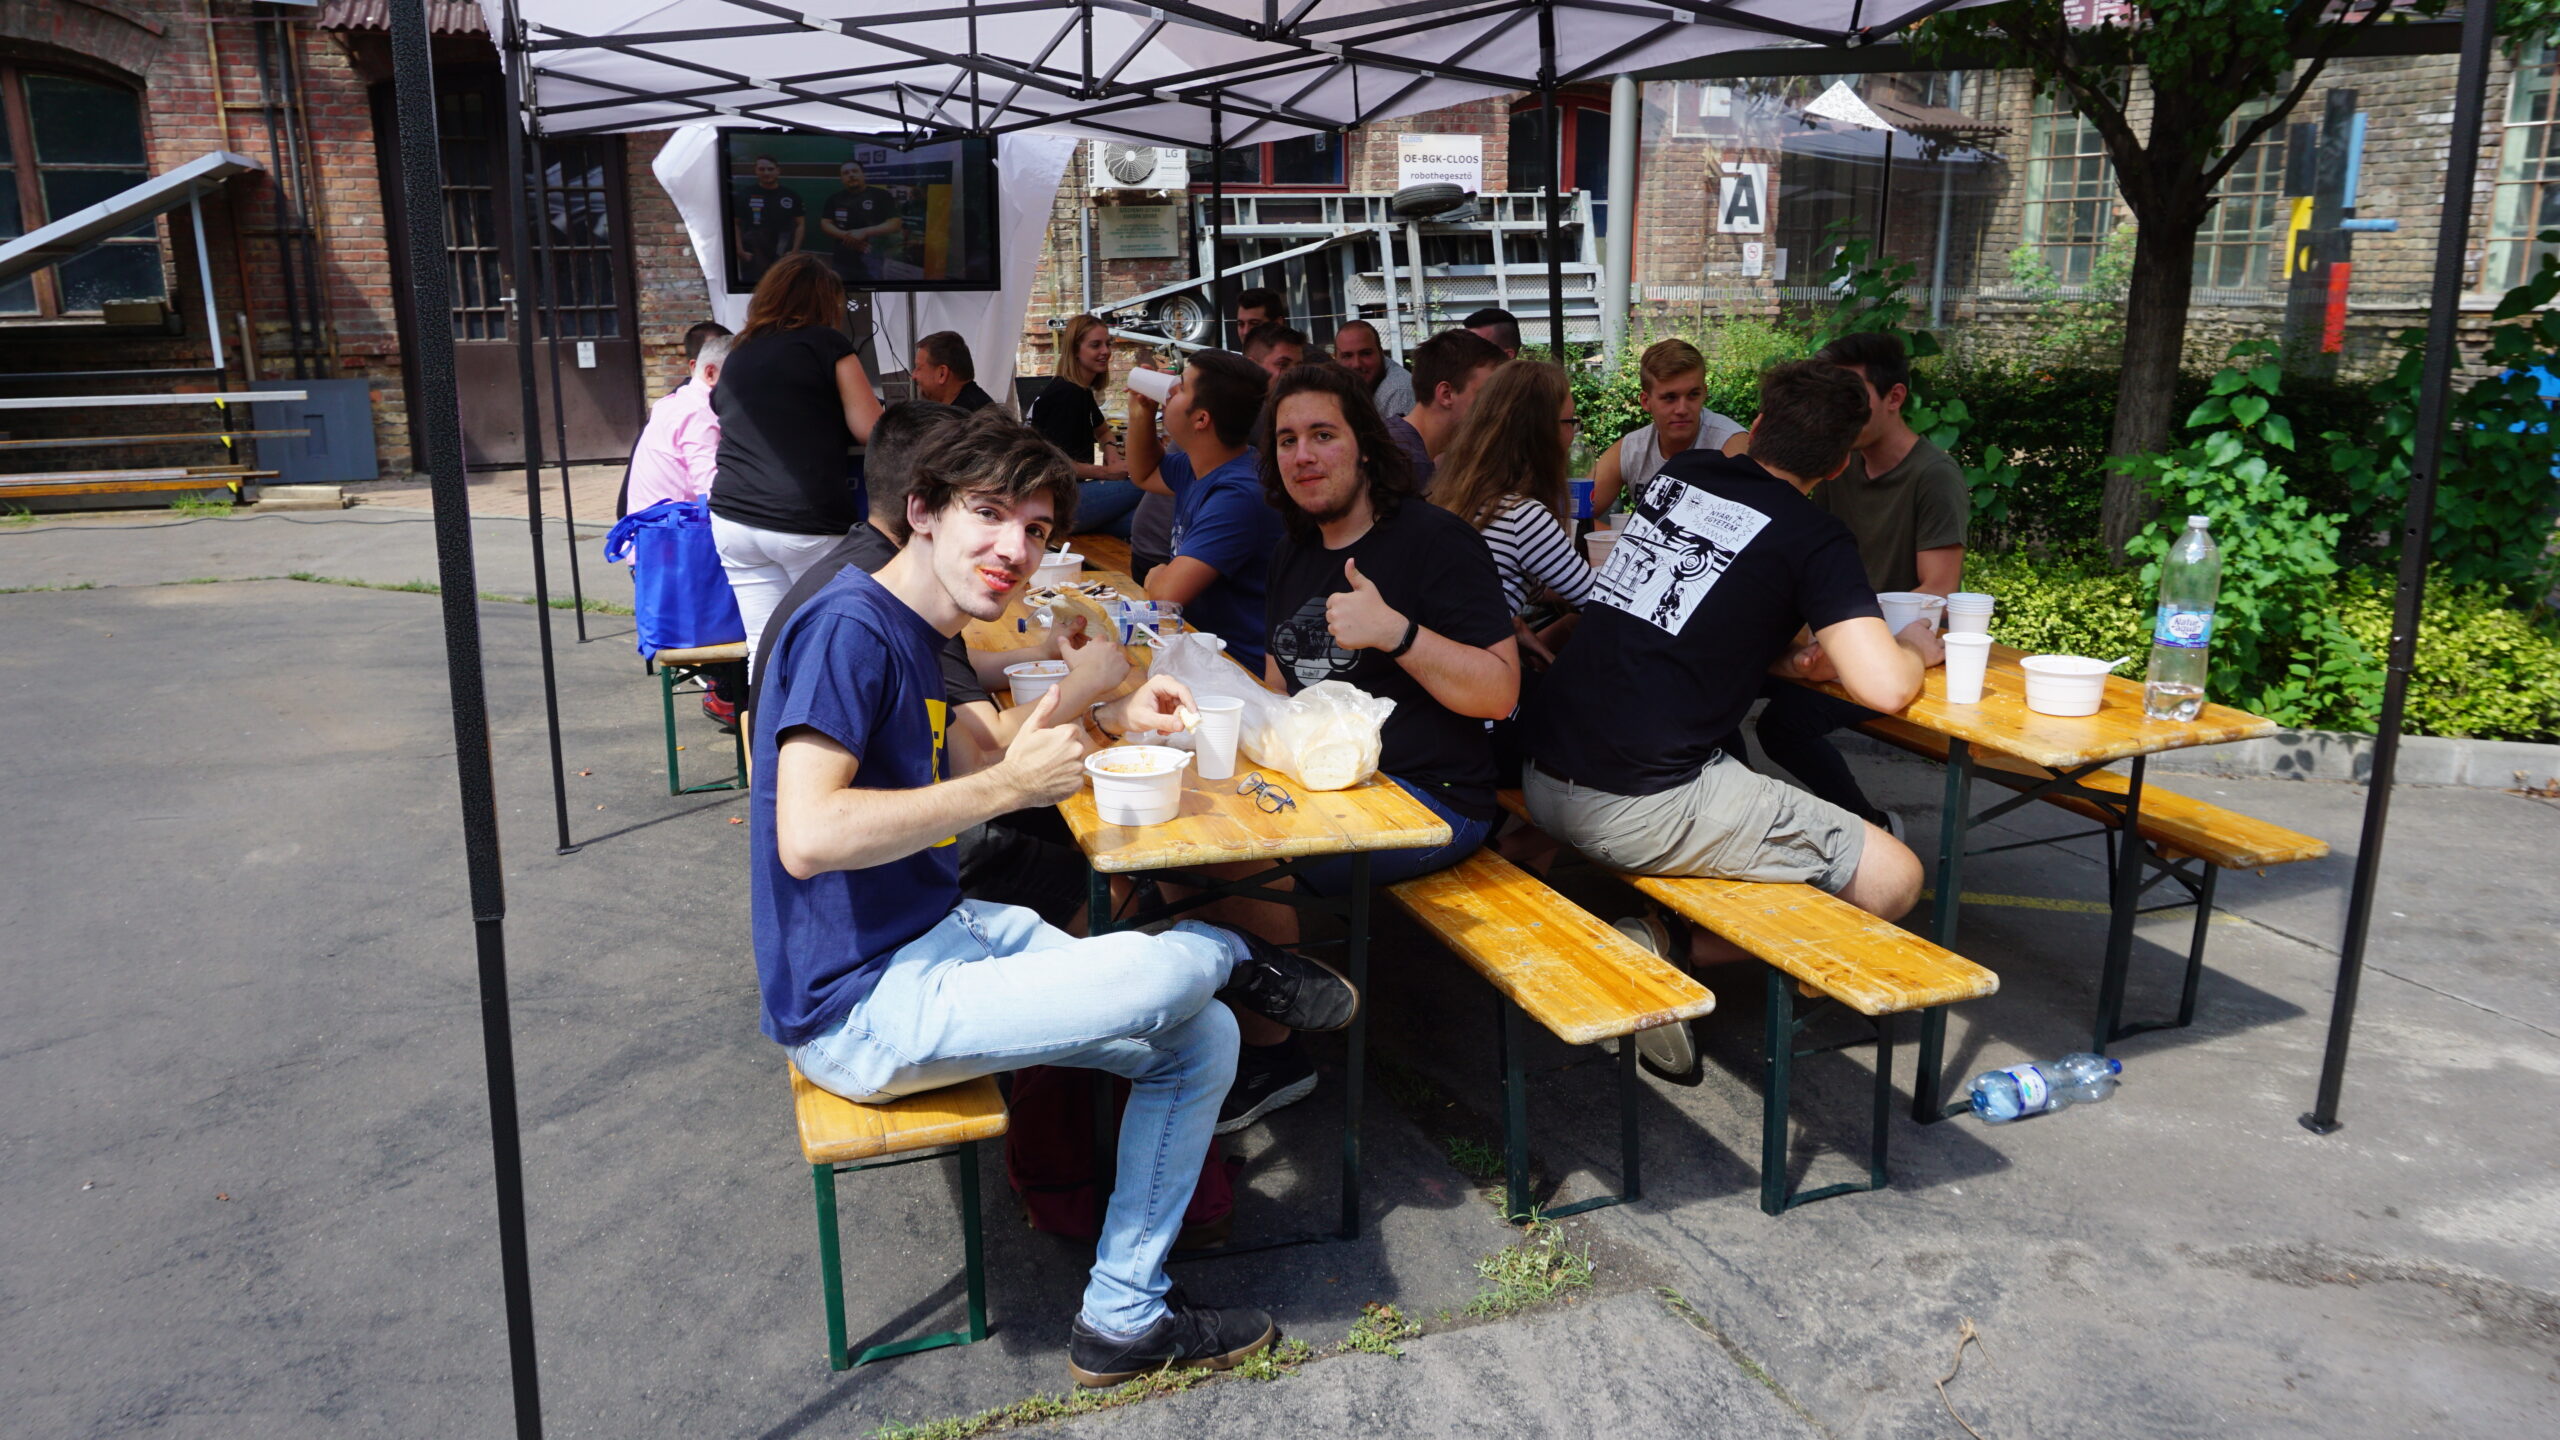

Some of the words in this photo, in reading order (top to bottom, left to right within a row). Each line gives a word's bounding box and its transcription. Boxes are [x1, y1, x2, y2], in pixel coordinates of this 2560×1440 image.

[1165, 149, 1178, 158] LG
[1403, 154, 1479, 164] OE-BGK-CLOOS
[1724, 174, 1760, 225] A
[1704, 516, 1738, 532] EGYETEM
